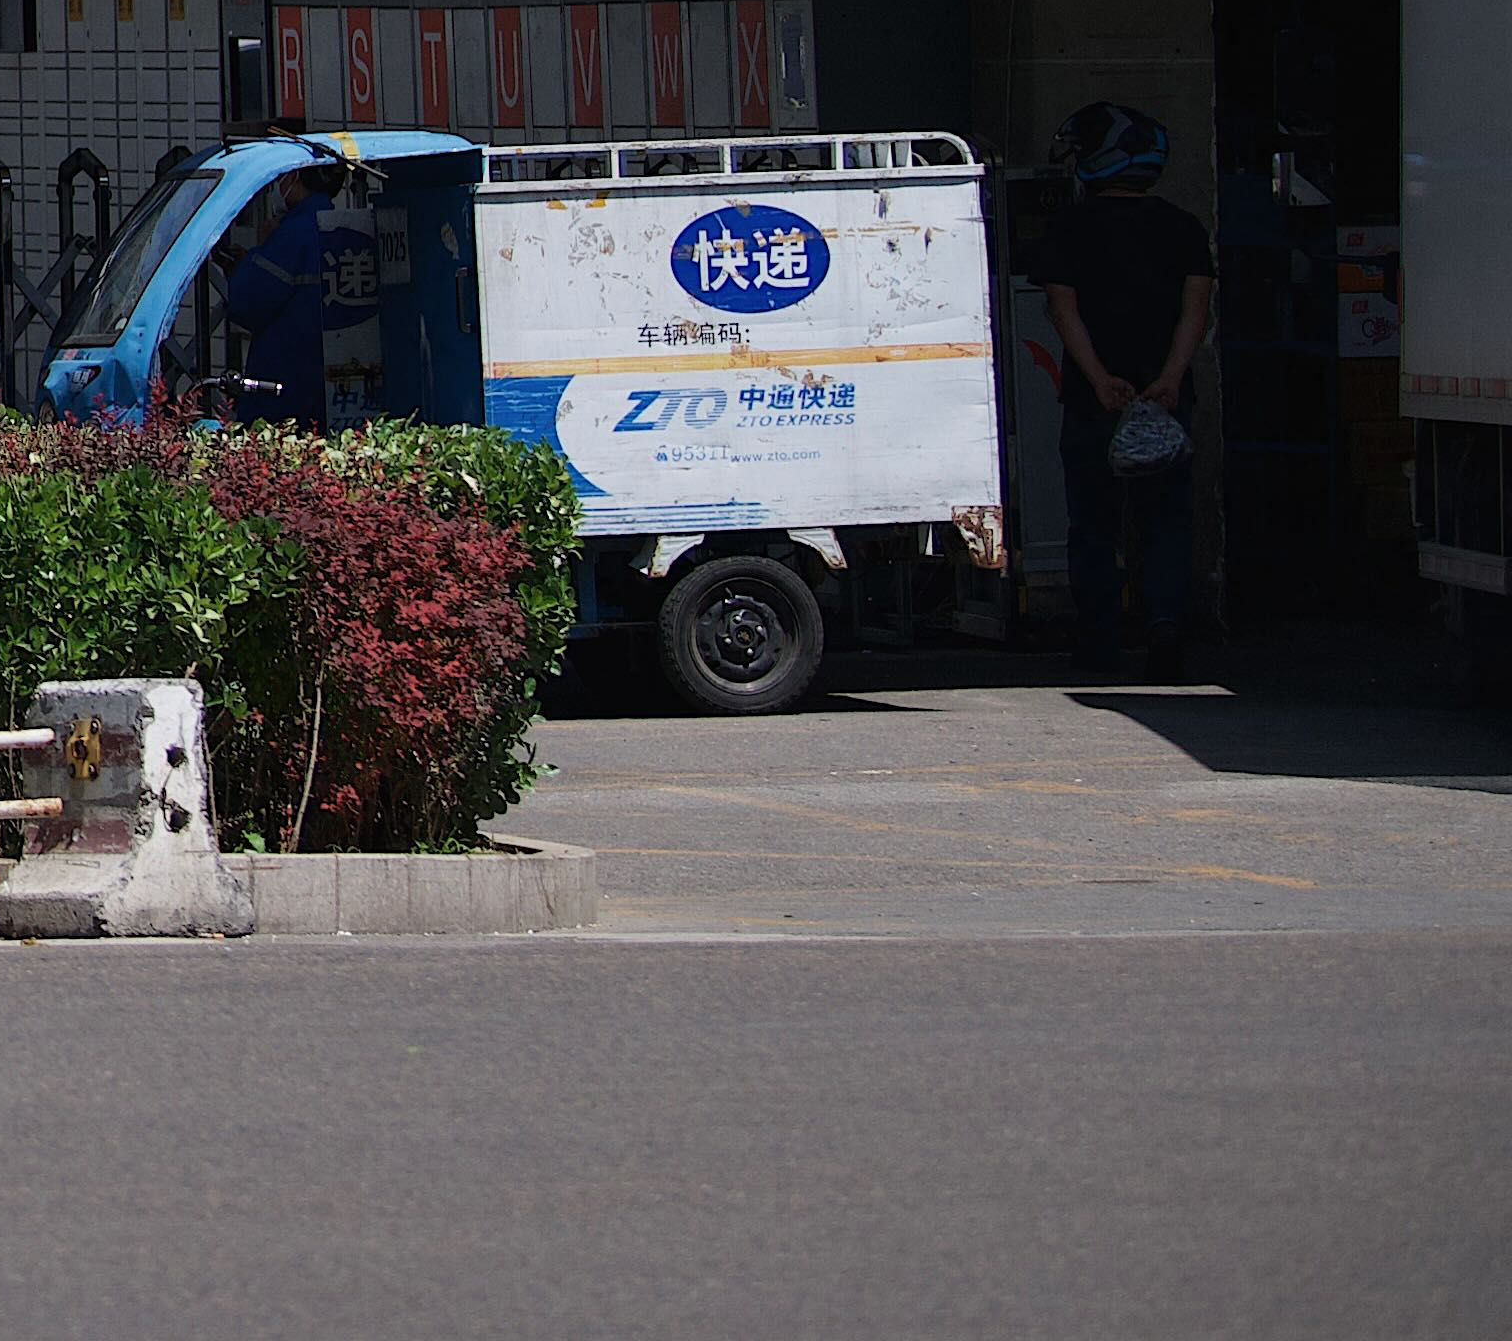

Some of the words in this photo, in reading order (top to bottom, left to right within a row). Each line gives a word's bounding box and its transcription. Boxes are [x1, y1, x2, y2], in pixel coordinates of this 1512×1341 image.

[283, 28, 304, 101] R
[350, 29, 371, 105] S
[423, 32, 442, 107] T
[498, 29, 520, 108] U
[574, 27, 596, 107] V
[653, 33, 679, 99] W
[739, 21, 765, 106] X
[691, 226, 810, 293] 快递
[612, 387, 728, 433] ZTO
[736, 415, 773, 428] ZTO
[775, 413, 856, 427] EXPRESS
[738, 382, 856, 412] 中通快递
